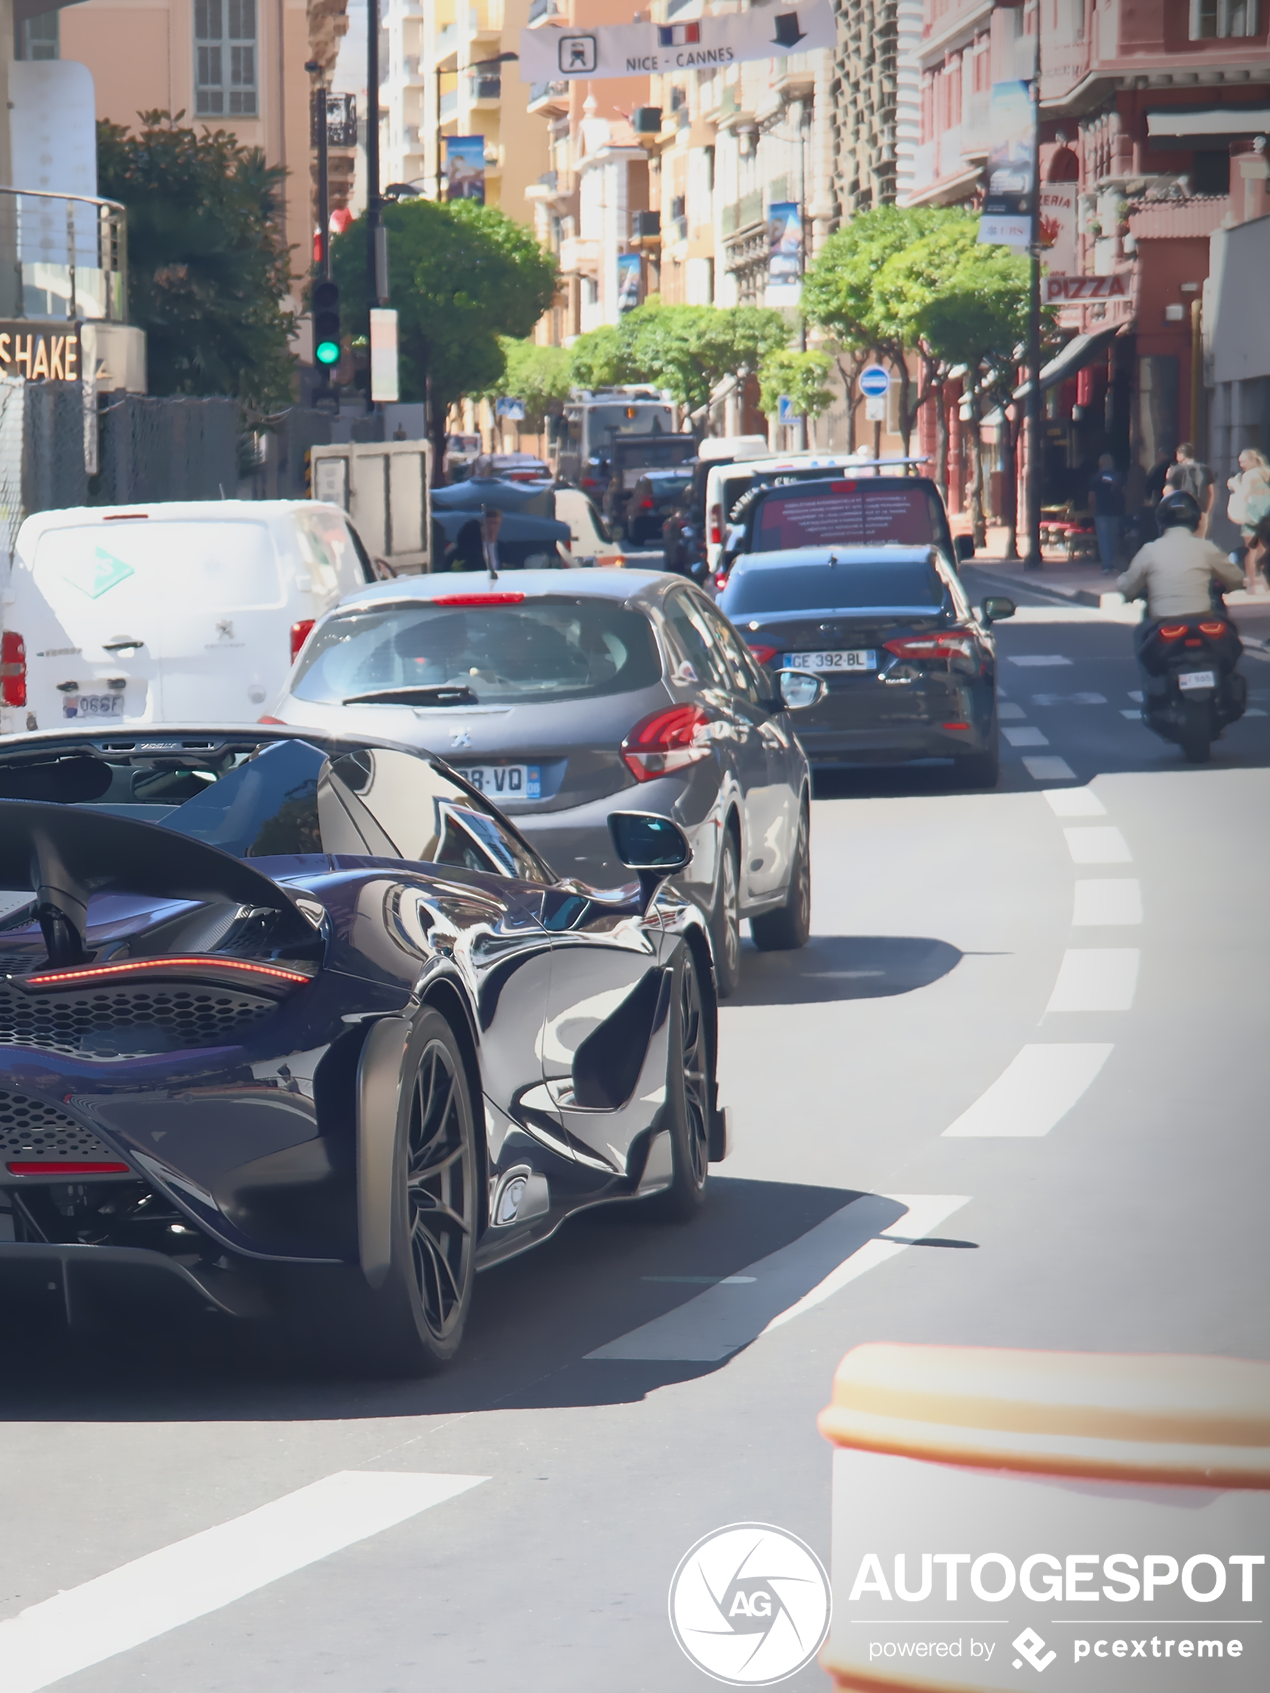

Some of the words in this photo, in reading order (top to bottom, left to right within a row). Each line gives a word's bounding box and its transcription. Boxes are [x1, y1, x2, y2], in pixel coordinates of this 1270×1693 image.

[626, 55, 658, 72] NICE
[675, 47, 735, 68] CANNES
[1047, 277, 1125, 301] PIZZA
